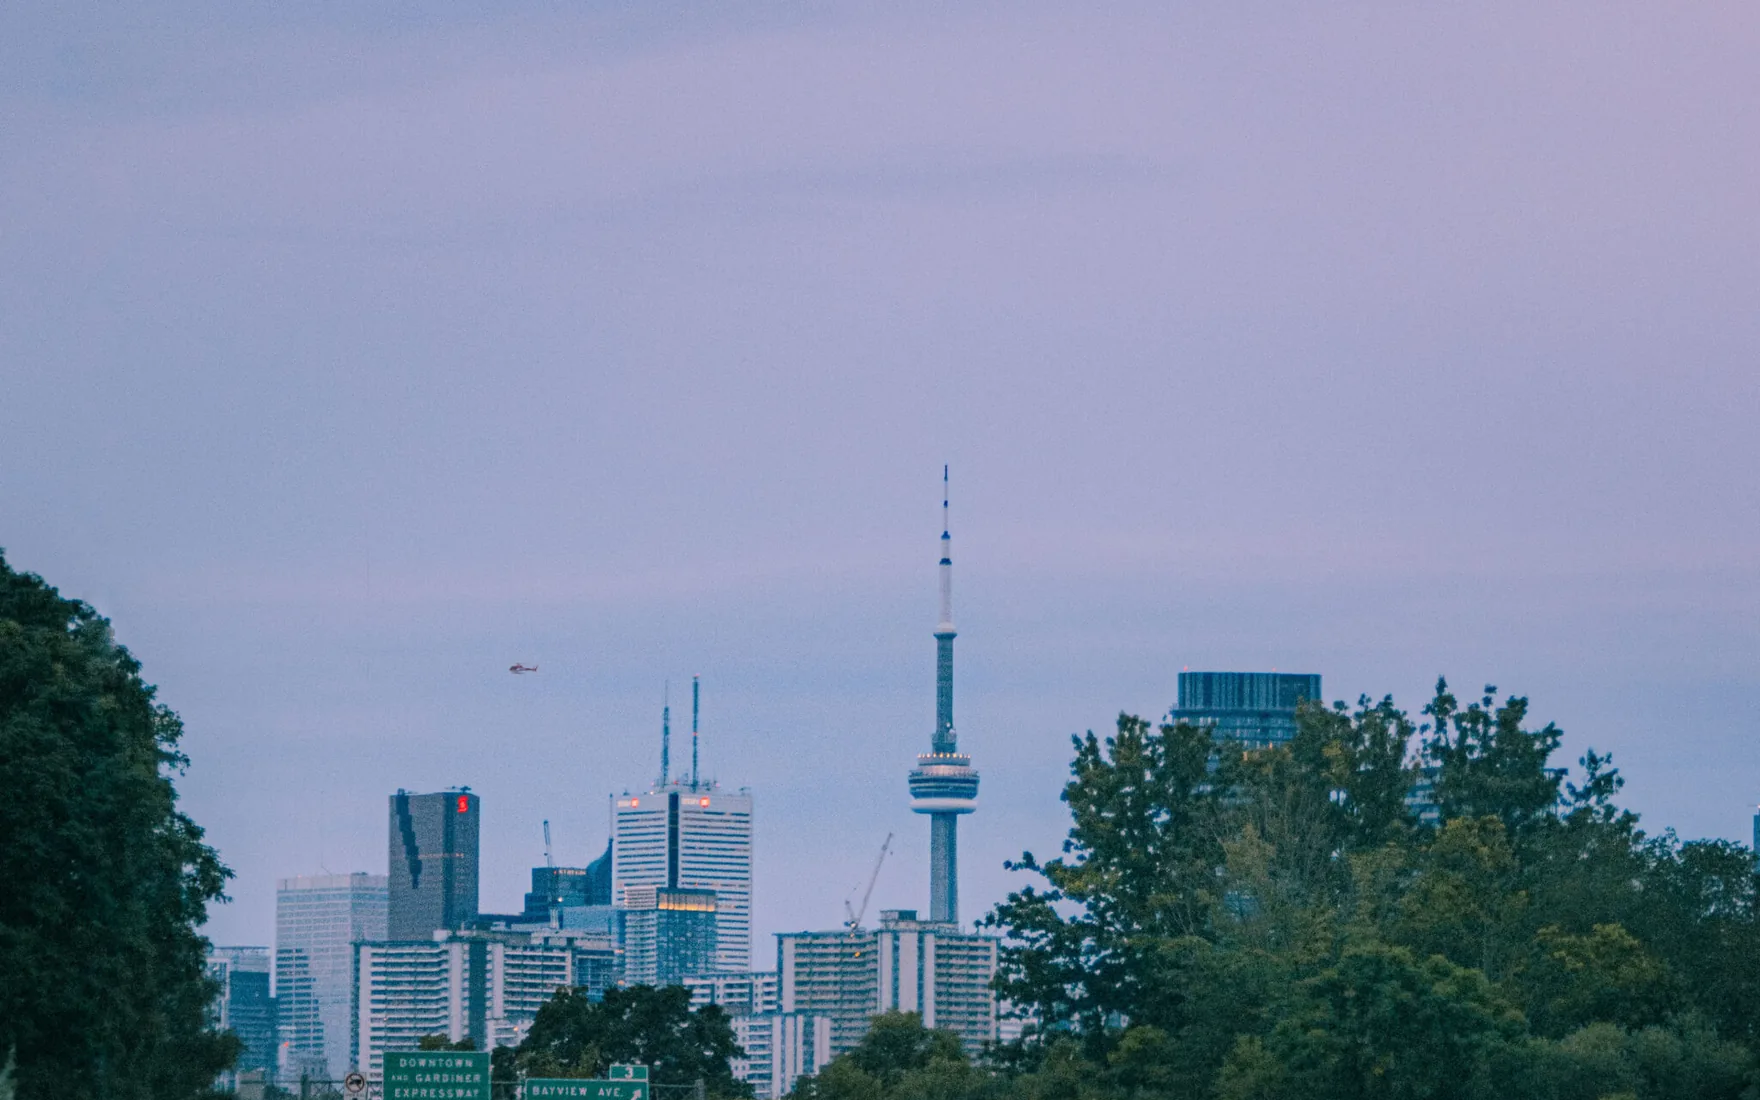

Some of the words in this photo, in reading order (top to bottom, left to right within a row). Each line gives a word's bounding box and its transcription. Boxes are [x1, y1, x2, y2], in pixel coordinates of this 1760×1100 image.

[399, 1058, 473, 1067] DOWNTOWN
[624, 1066, 634, 1079] 3
[415, 1074, 481, 1083] GARDINER
[394, 1089, 479, 1098] EXPRESSWAY
[532, 1086, 587, 1096] BAYVIEW
